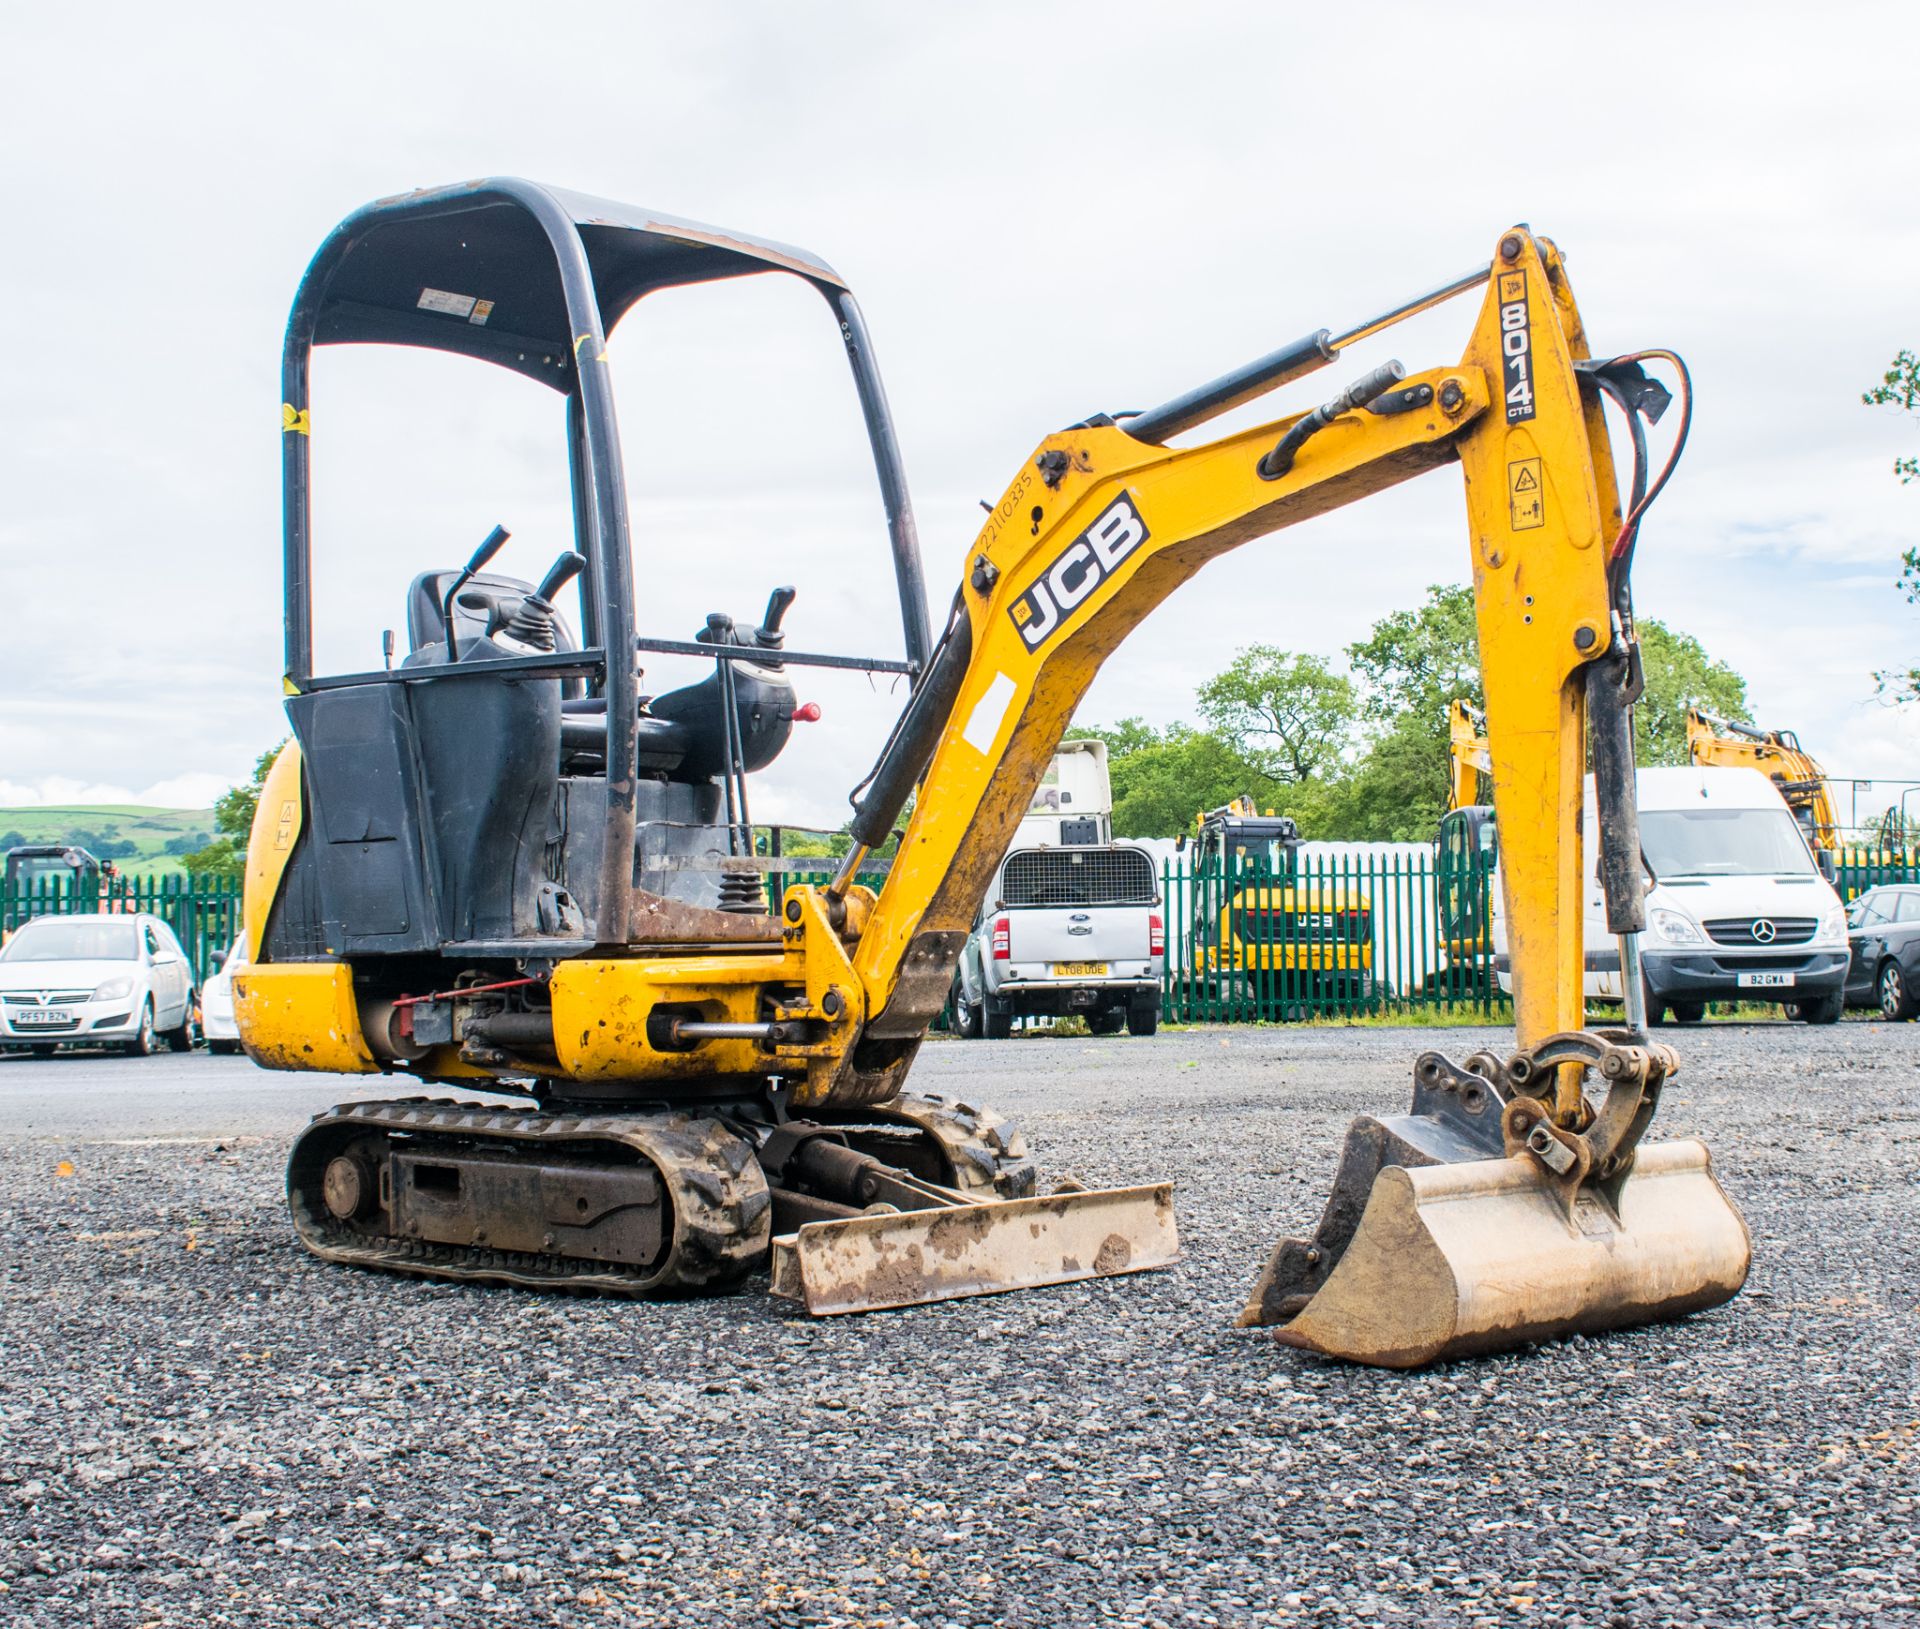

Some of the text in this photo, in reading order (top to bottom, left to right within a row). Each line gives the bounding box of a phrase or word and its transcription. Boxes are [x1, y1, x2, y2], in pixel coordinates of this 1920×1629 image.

[1501, 302, 1533, 406] 8014
[1508, 405, 1533, 418] CTS
[980, 471, 1032, 552] 22110335
[1022, 501, 1143, 645] JCB
[1751, 975, 1784, 984] B2 GWA
[20, 1012, 68, 1021] PF57 BZN
